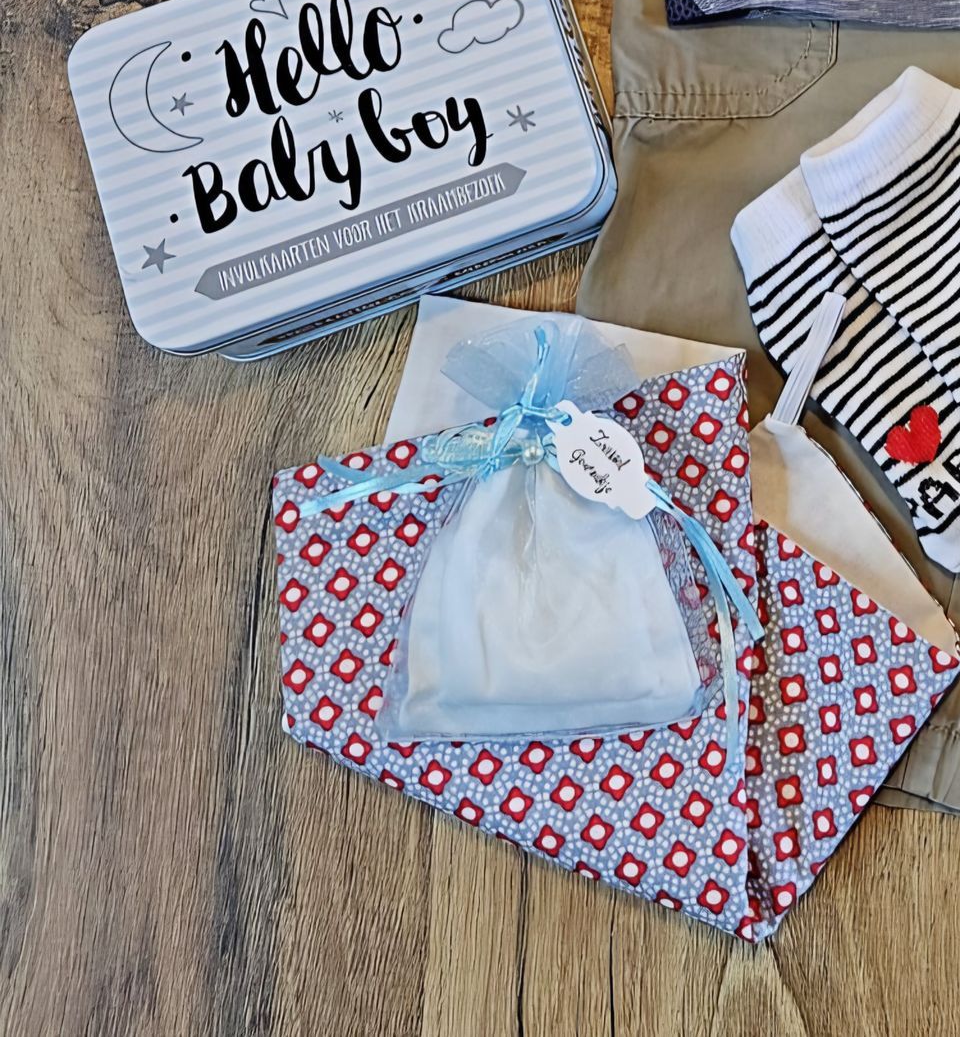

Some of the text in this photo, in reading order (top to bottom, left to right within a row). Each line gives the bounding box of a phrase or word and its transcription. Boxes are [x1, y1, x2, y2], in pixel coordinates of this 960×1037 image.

[182, 88, 494, 234] Baby boy
[218, 172, 506, 292] INVULKAARTEN VOOR HET KRAAMBEZOEK
